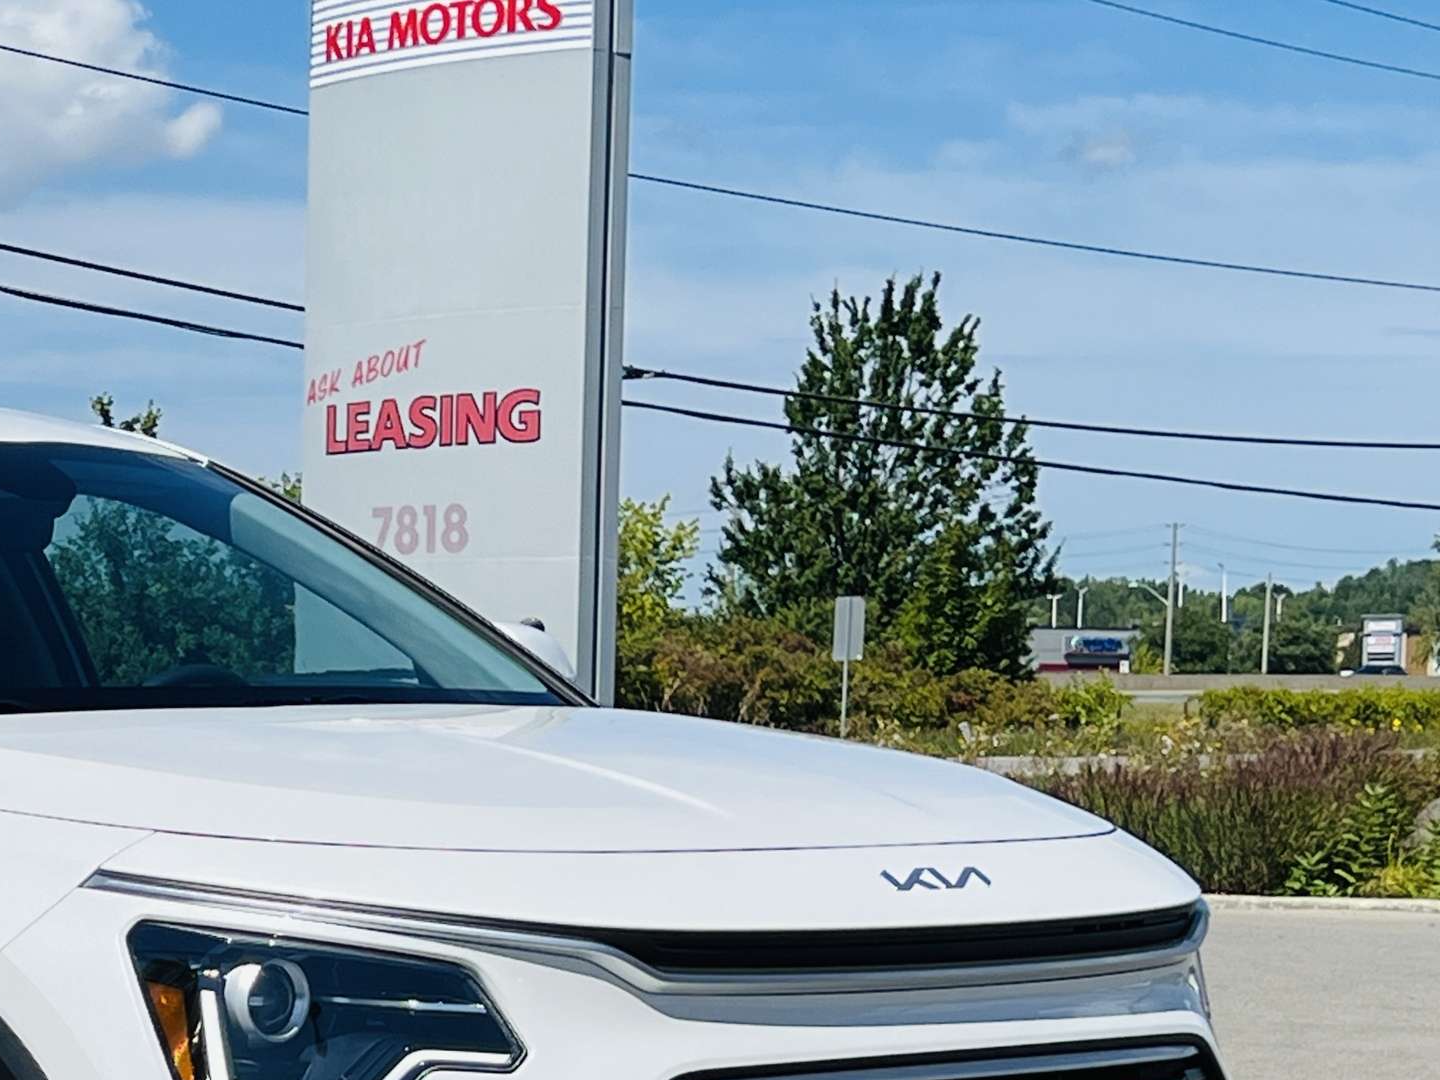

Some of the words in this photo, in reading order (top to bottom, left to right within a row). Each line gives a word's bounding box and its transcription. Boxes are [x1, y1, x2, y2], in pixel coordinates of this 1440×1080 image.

[325, 17, 376, 63] KIA
[387, 0, 564, 50] MOTORS
[307, 369, 342, 404] ASK
[353, 339, 427, 388] ABOUT
[325, 388, 541, 456] LEASING
[371, 503, 469, 556] 7818
[880, 866, 991, 891] KIA
